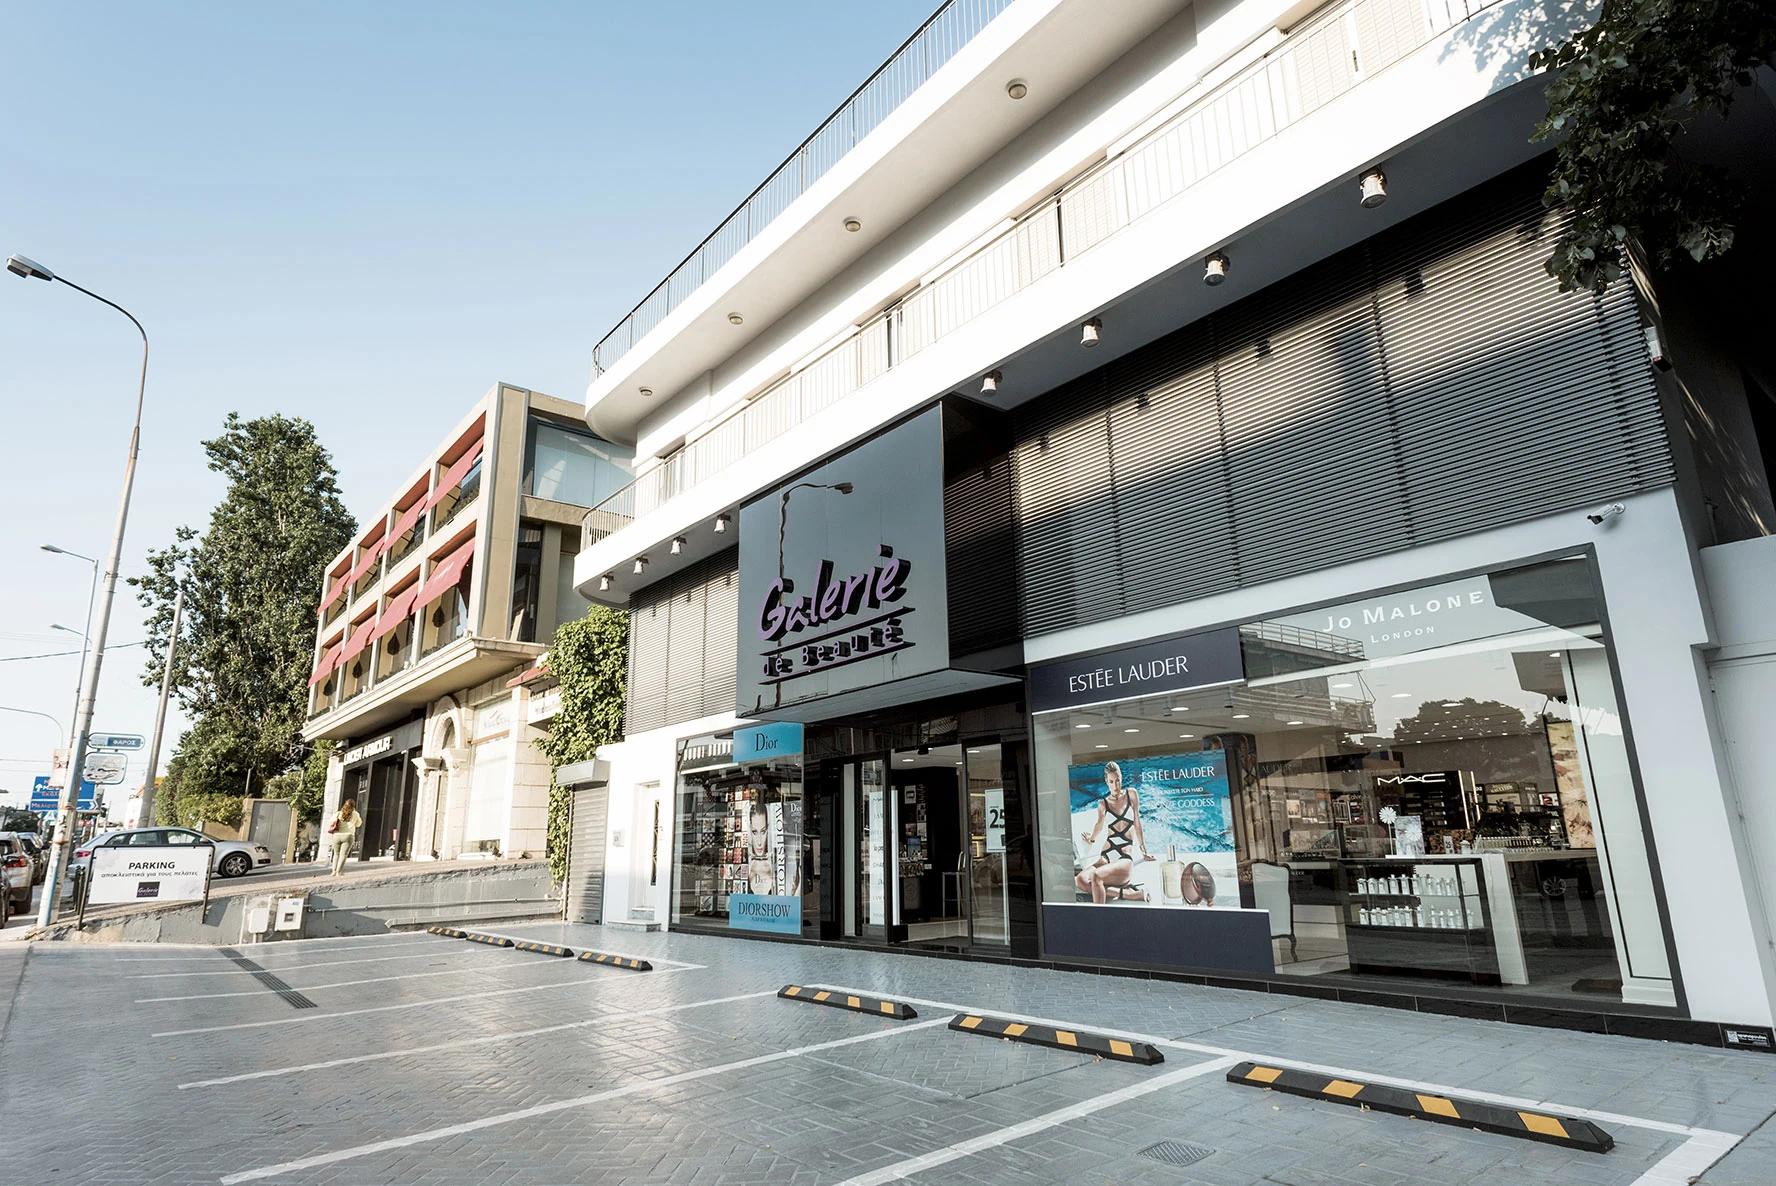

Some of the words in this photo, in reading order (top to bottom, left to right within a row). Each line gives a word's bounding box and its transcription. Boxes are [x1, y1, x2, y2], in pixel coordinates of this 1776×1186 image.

[757, 544, 910, 641] Galerie
[1362, 591, 1485, 625] MALONE
[1370, 626, 1435, 644] LONDON
[763, 656, 792, 676] de
[801, 618, 904, 666] Beauté
[1118, 655, 1189, 684] LAUDER
[755, 732, 779, 752] Dior
[1172, 765, 1215, 780] LAUDER
[1177, 797, 1215, 809] GODDESS
[128, 861, 176, 870] PARKING
[738, 901, 791, 918] DIORSHOW
